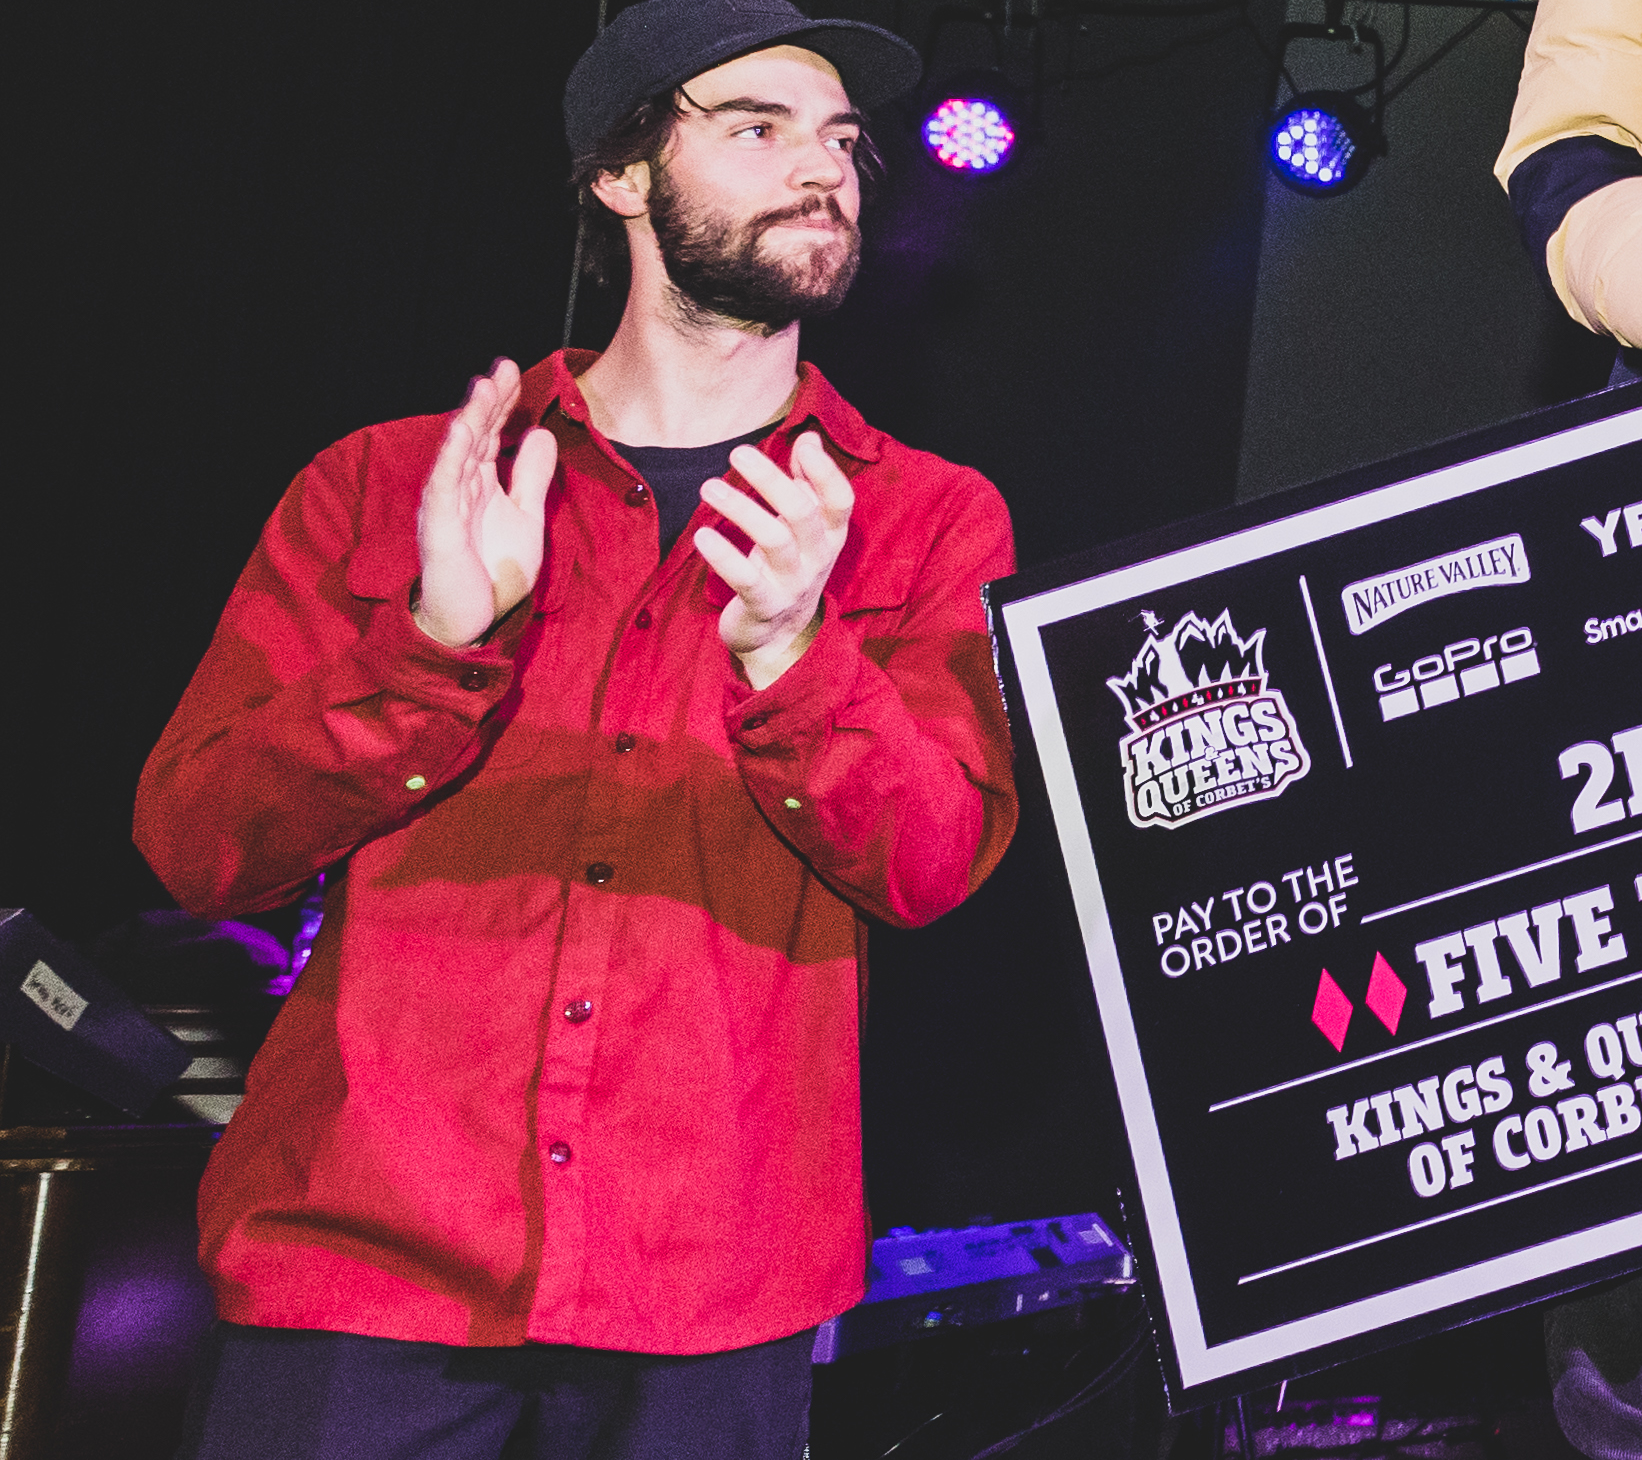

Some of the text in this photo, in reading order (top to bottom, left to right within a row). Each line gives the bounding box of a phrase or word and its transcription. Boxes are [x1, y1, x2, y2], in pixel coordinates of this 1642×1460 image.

[1351, 543, 1515, 626] NATURE VALLEY
[1374, 627, 1532, 691] GoPro
[1131, 699, 1286, 786] KINGS
[1137, 740, 1300, 818] QUEENS
[1172, 776, 1272, 817] OF CORBET'S
[1153, 853, 1358, 945] PAY TO THE
[1161, 893, 1347, 977] ORDER OF
[1415, 885, 1627, 1018] FIVE
[1327, 1056, 1513, 1160] KINGS
[1526, 1043, 1575, 1097] &
[1410, 1129, 1475, 1197] OF
